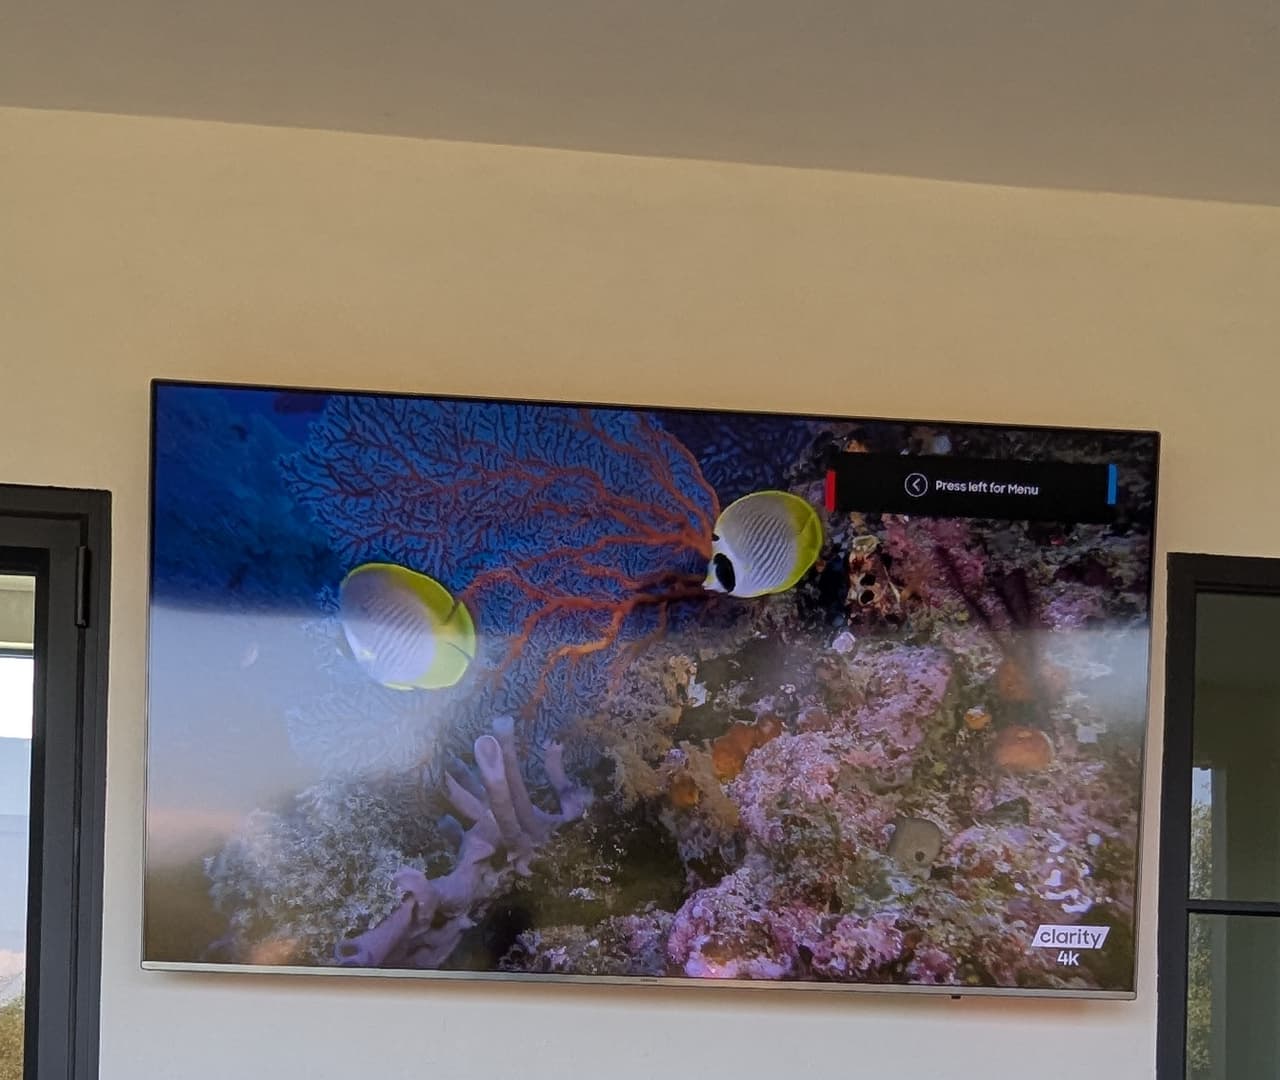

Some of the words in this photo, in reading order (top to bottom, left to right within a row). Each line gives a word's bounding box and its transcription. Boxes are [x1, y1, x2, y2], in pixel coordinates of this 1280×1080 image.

[935, 480, 967, 492] Press
[968, 481, 988, 493] left
[989, 481, 1006, 494] for
[1007, 483, 1039, 495] Menu
[1040, 929, 1101, 949] clarity
